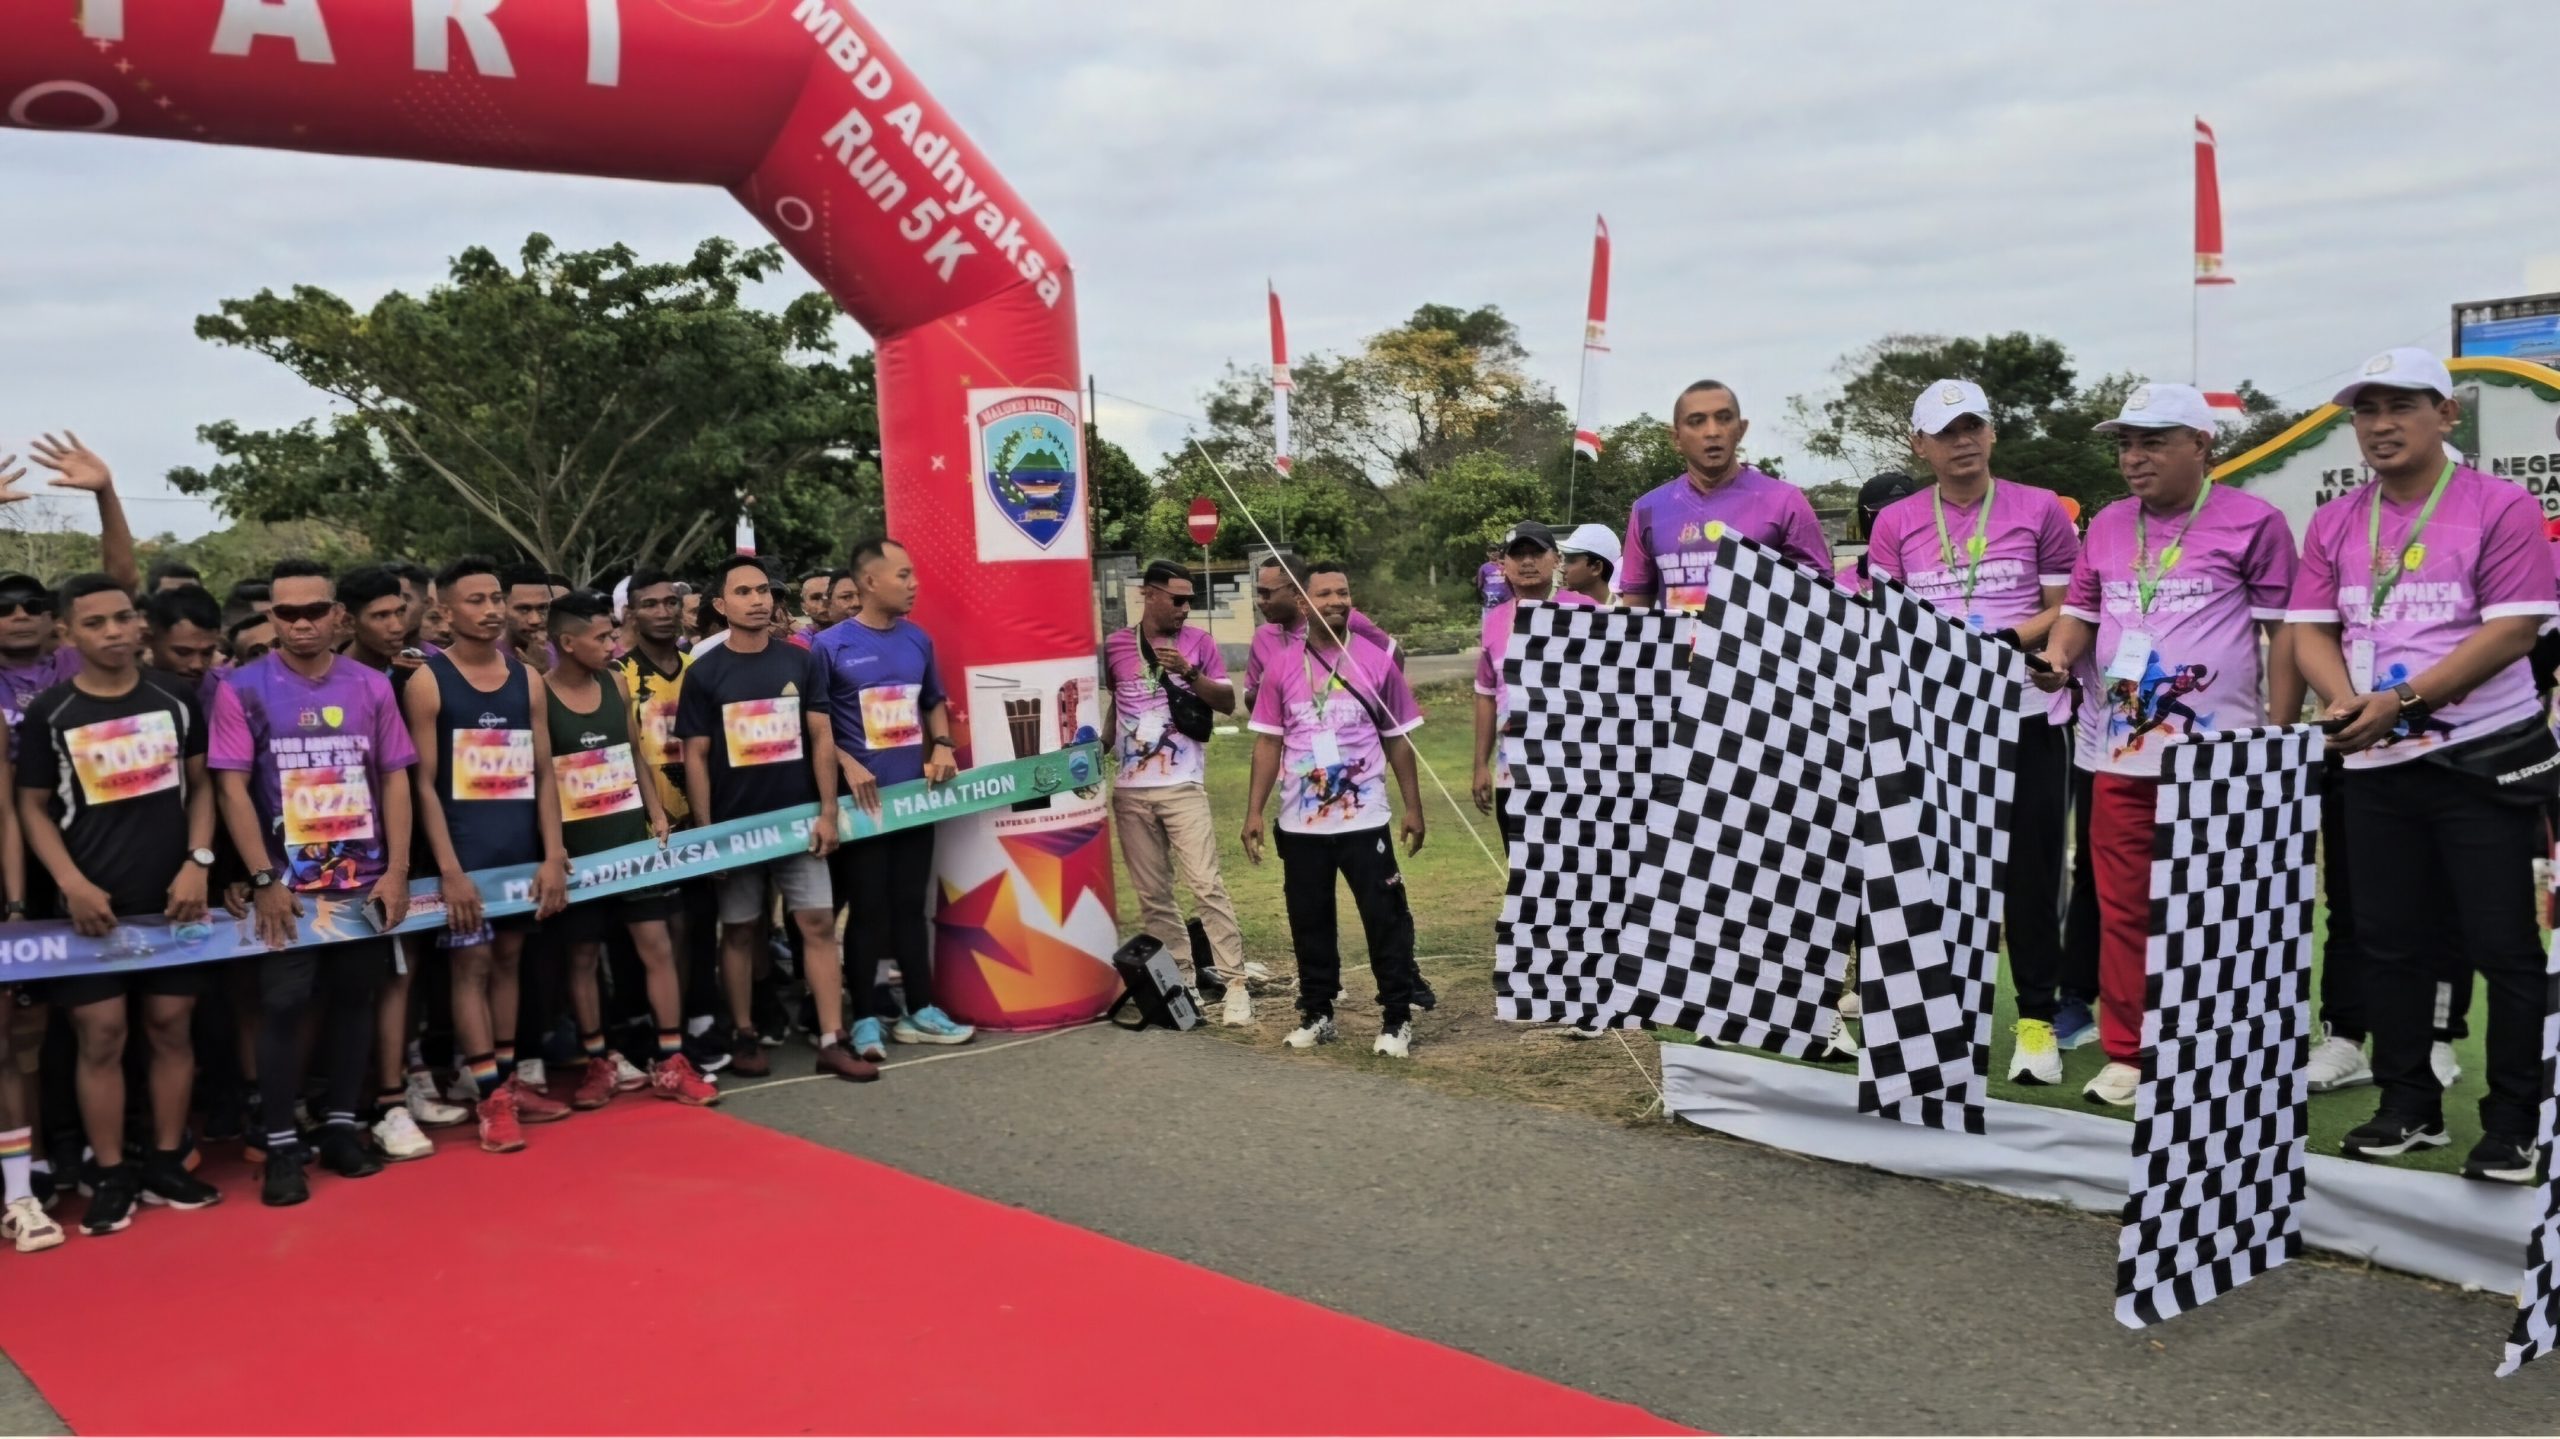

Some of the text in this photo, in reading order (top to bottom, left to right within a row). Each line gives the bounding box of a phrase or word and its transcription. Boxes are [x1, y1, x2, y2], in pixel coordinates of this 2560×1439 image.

[791, 0, 1062, 310] MBD Adhyaksa
[821, 107, 908, 213] Run
[578, 839, 721, 889] ADHYAKSA
[729, 825, 782, 856] RUN
[893, 772, 1017, 818] MARATHON
